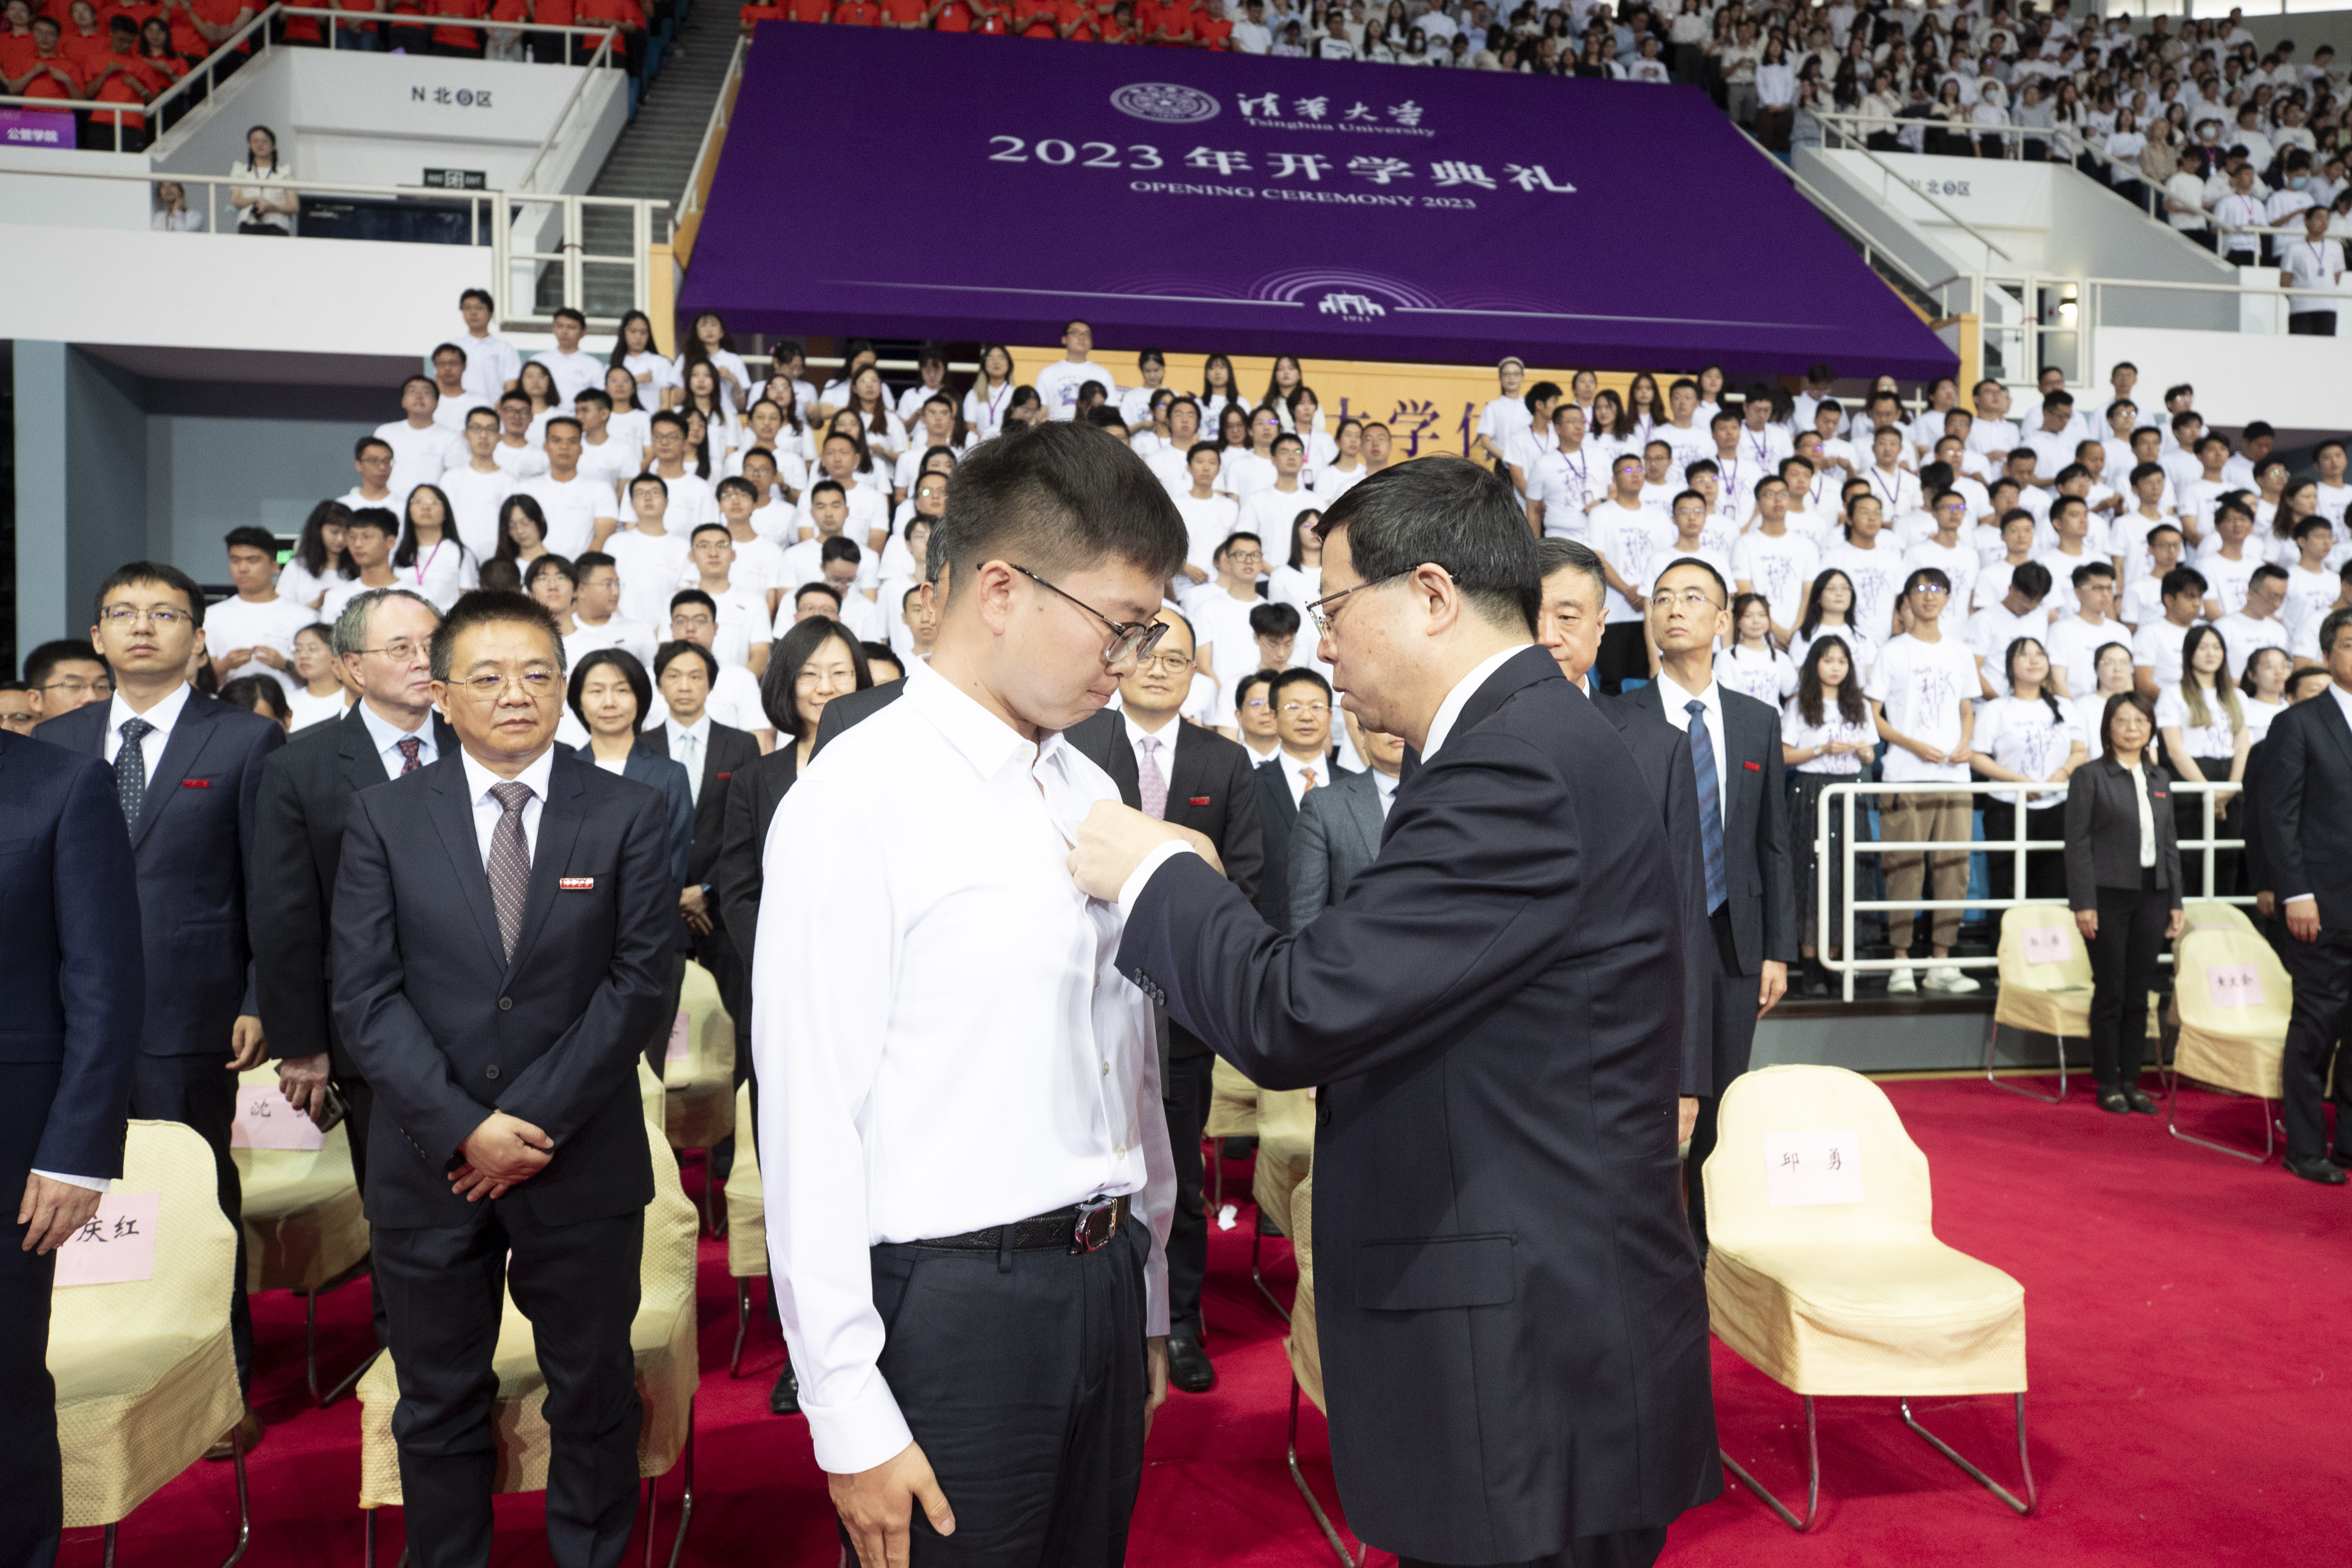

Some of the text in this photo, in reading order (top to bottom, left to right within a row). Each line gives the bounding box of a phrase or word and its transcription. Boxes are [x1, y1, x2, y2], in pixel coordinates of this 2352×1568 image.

[411, 86, 426, 101] N
[1244, 117, 1436, 138] Tsinghua University
[1130, 181, 1477, 209] OPENING CEREMONY 2023
[69, 1215, 140, 1243] 庆红
